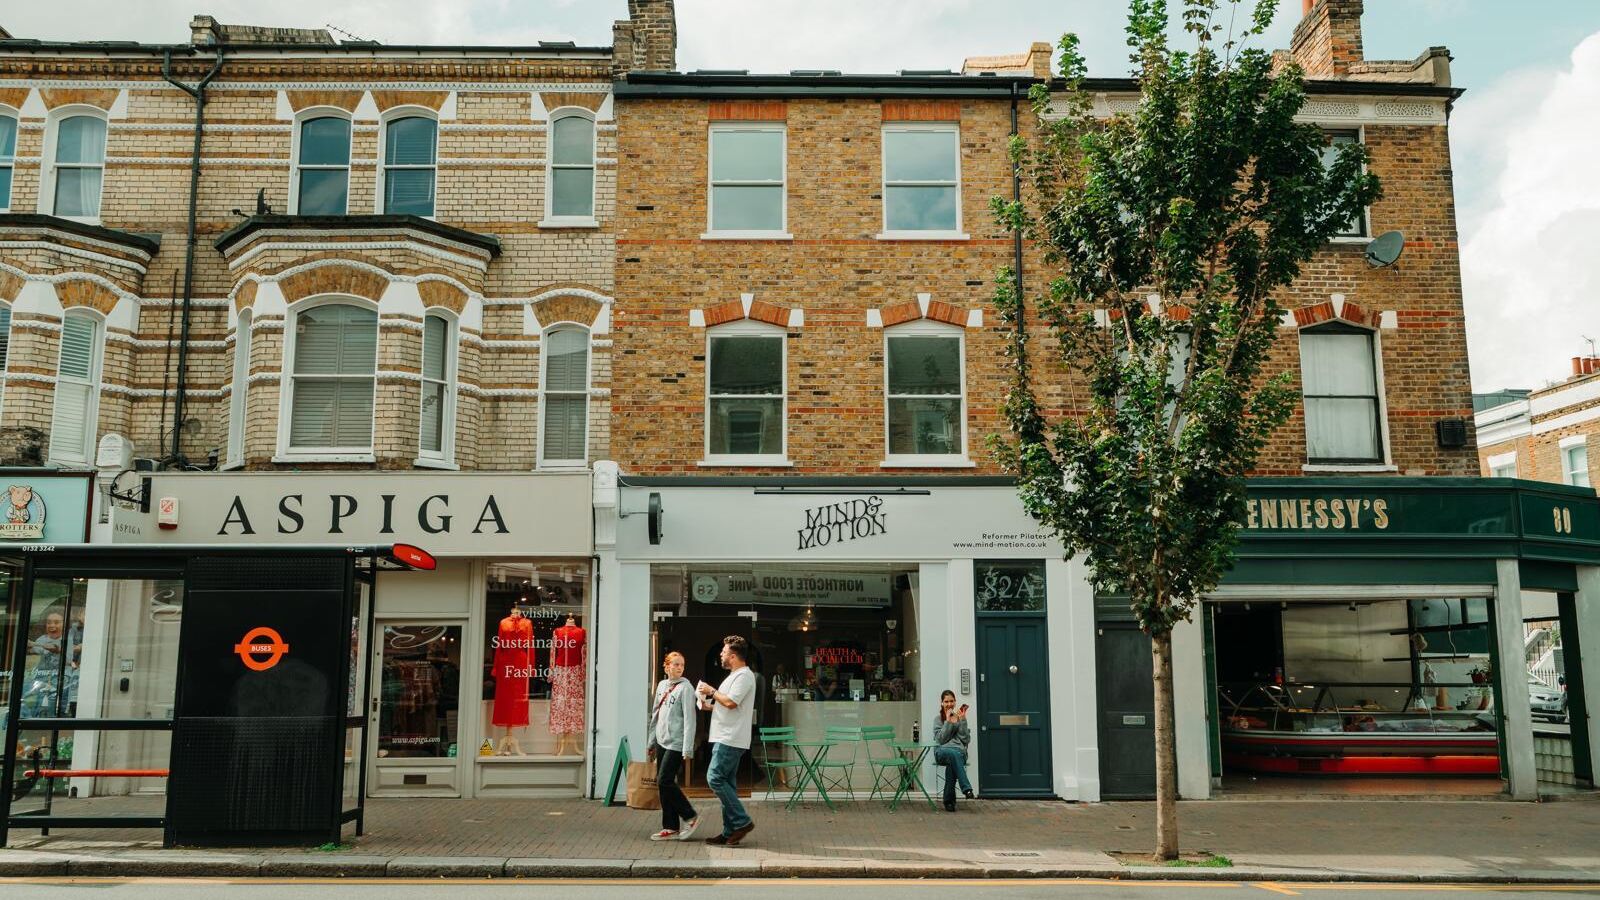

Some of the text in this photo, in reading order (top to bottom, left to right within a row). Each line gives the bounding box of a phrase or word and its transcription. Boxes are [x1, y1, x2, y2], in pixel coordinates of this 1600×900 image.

[217, 494, 510, 535] ASPIGA
[805, 499, 868, 529] MIND
[1238, 498, 1389, 529] ENNESSY'S
[1553, 506, 1571, 533] 80
[115, 523, 141, 536] ASPIGA
[797, 513, 887, 550] MOTION
[953, 541, 1047, 549] www.mind-motion.co.uk
[697, 584, 714, 596] 82
[984, 575, 1034, 599] 82A
[517, 607, 561, 621] ylishly
[491, 635, 577, 649] Sustainable
[815, 647, 849, 656] HEALTH
[840, 655, 863, 664] CLUB
[392, 736, 441, 744] www.aspiga.com
